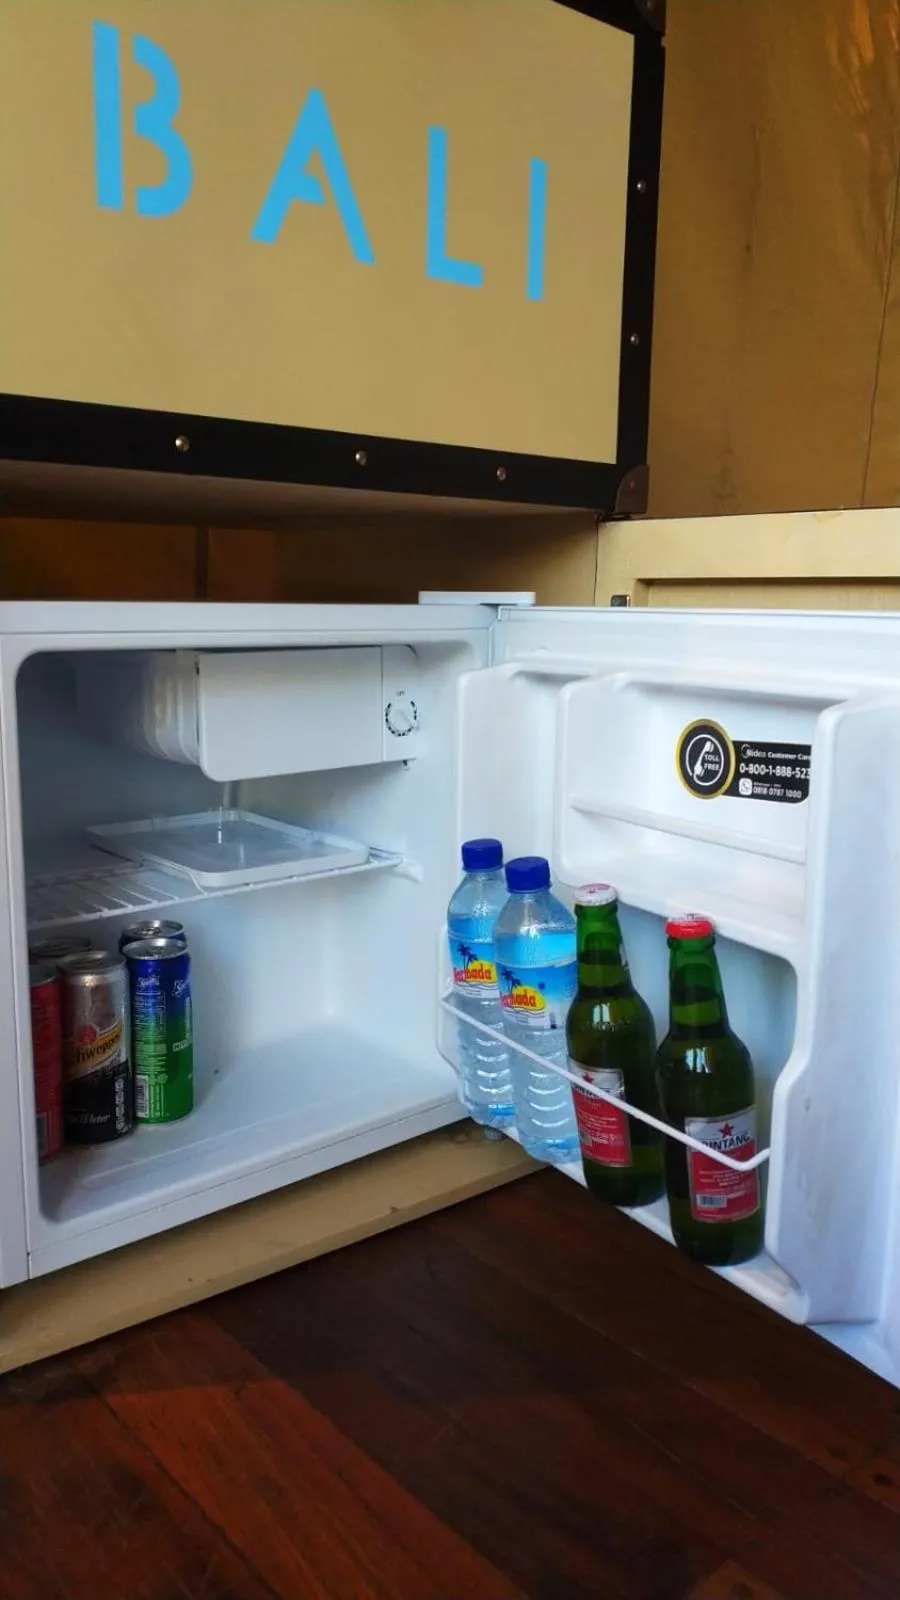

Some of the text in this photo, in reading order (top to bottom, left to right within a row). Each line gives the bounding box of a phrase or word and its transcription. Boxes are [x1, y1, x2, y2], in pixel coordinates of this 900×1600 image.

[93, 21, 547, 301] BALI
[704, 754, 719, 762] TOLL
[703, 763, 719, 771] FREE
